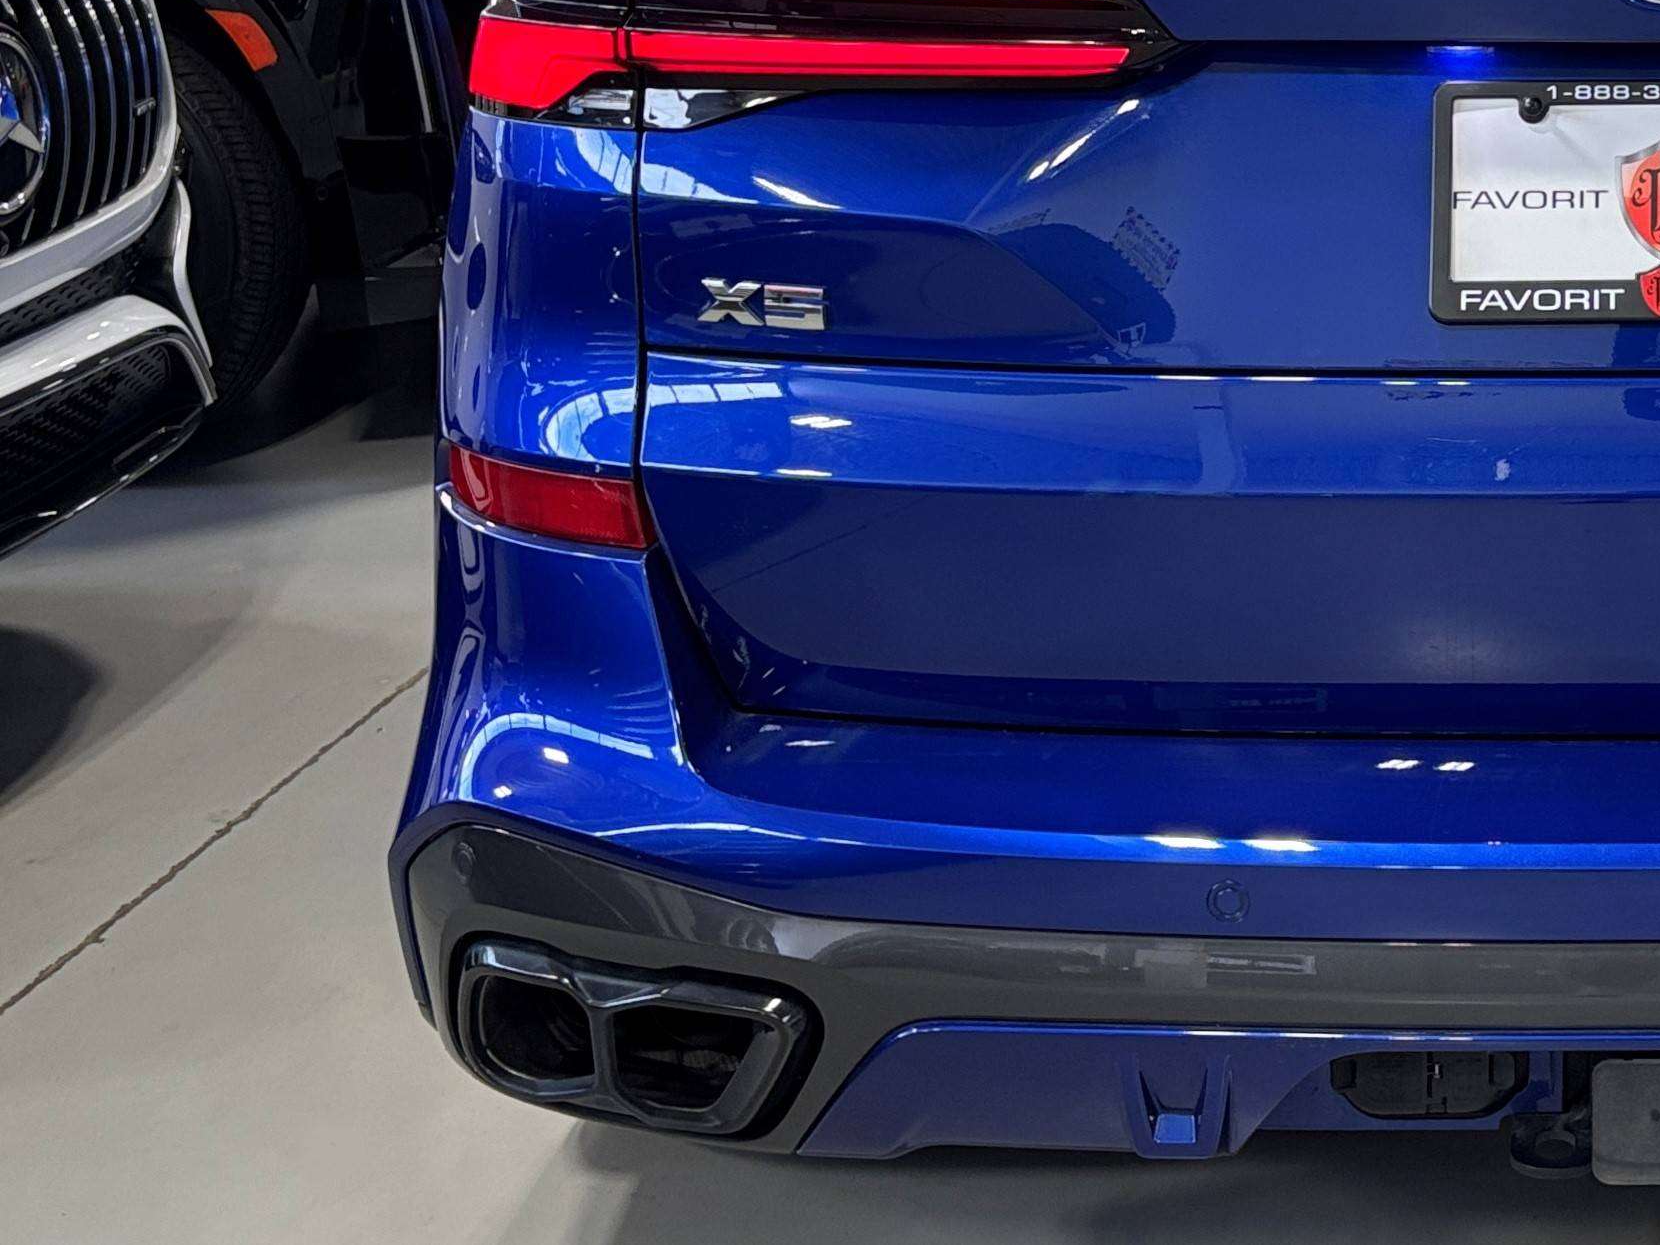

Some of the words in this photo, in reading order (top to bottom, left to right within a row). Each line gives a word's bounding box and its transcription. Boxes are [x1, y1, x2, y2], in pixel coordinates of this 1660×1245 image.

[1453, 189, 1610, 210] FAVORIT
[697, 277, 826, 331] X5
[1459, 288, 1626, 312] FAVORIT
